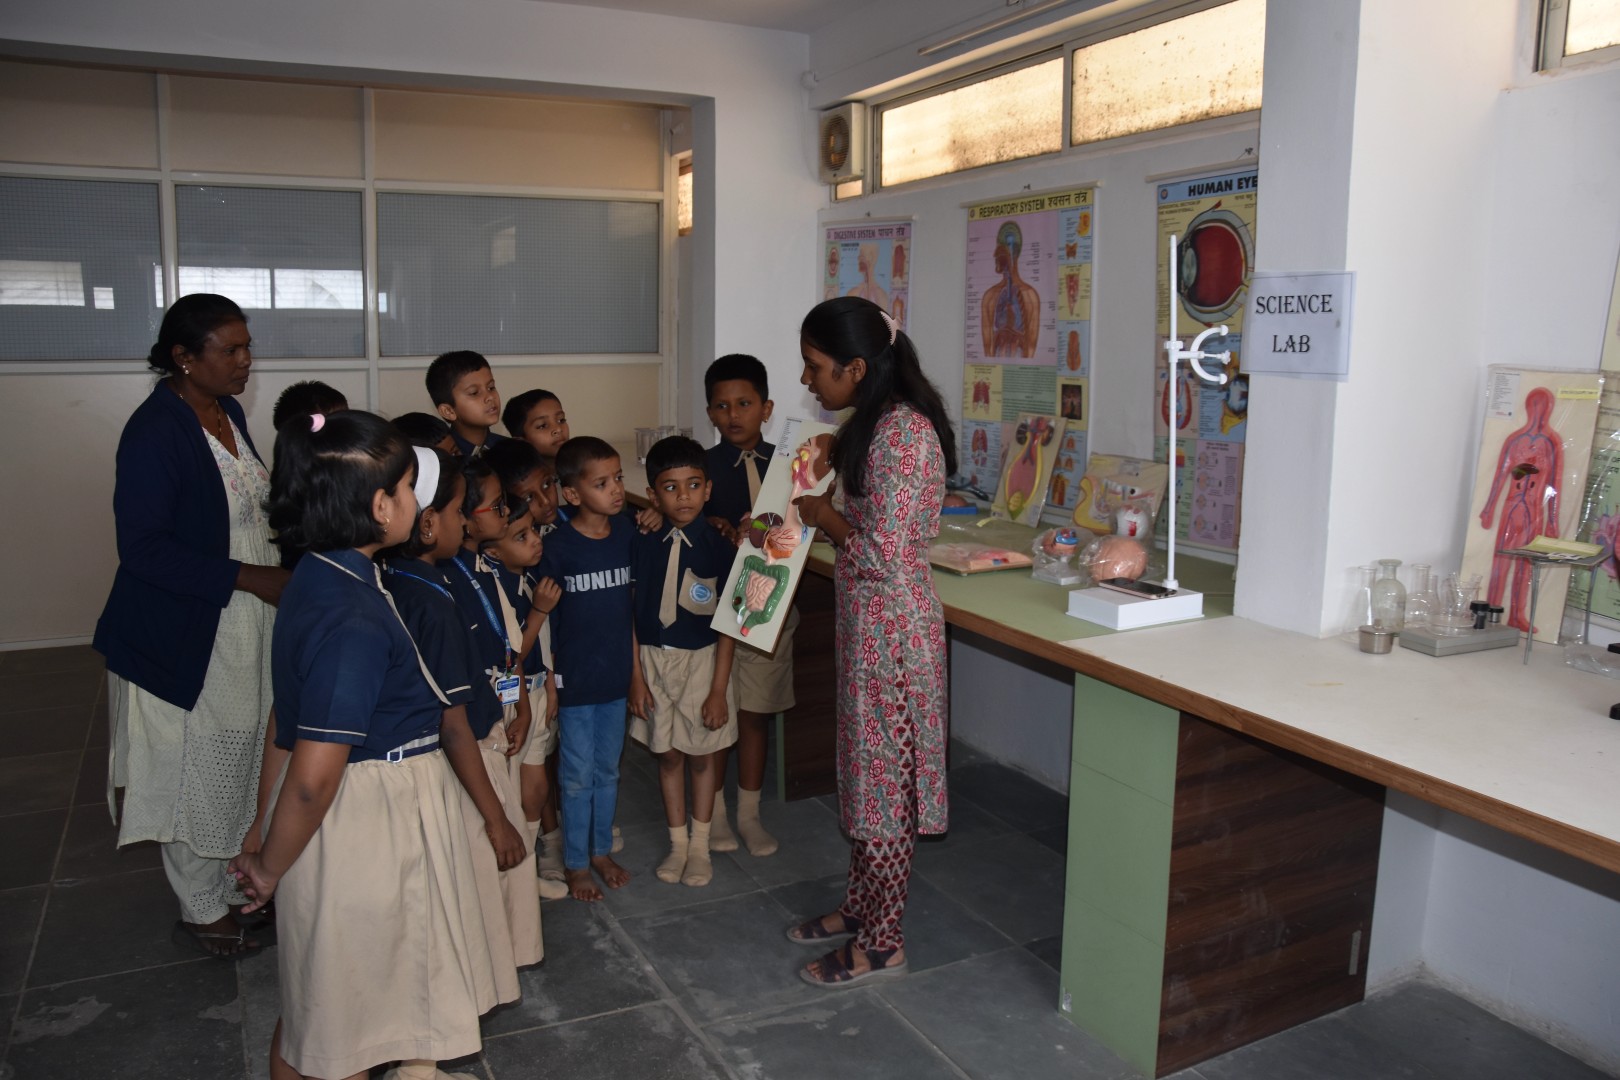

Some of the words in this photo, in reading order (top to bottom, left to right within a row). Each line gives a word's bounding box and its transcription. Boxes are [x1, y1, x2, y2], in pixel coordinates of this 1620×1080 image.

[1188, 179, 1233, 197] HUMAN
[1237, 175, 1258, 190] EYE
[979, 202, 1018, 218] RESPIRATORY
[1019, 198, 1045, 213] SYSTEM
[1047, 194, 1071, 207] श्वसन
[1074, 191, 1088, 204] तंत्र
[834, 230, 856, 240] DIGESTIVE
[857, 229, 875, 239] SYSTEM
[1255, 294, 1333, 314] SCIENCE
[1272, 334, 1311, 353] LAB
